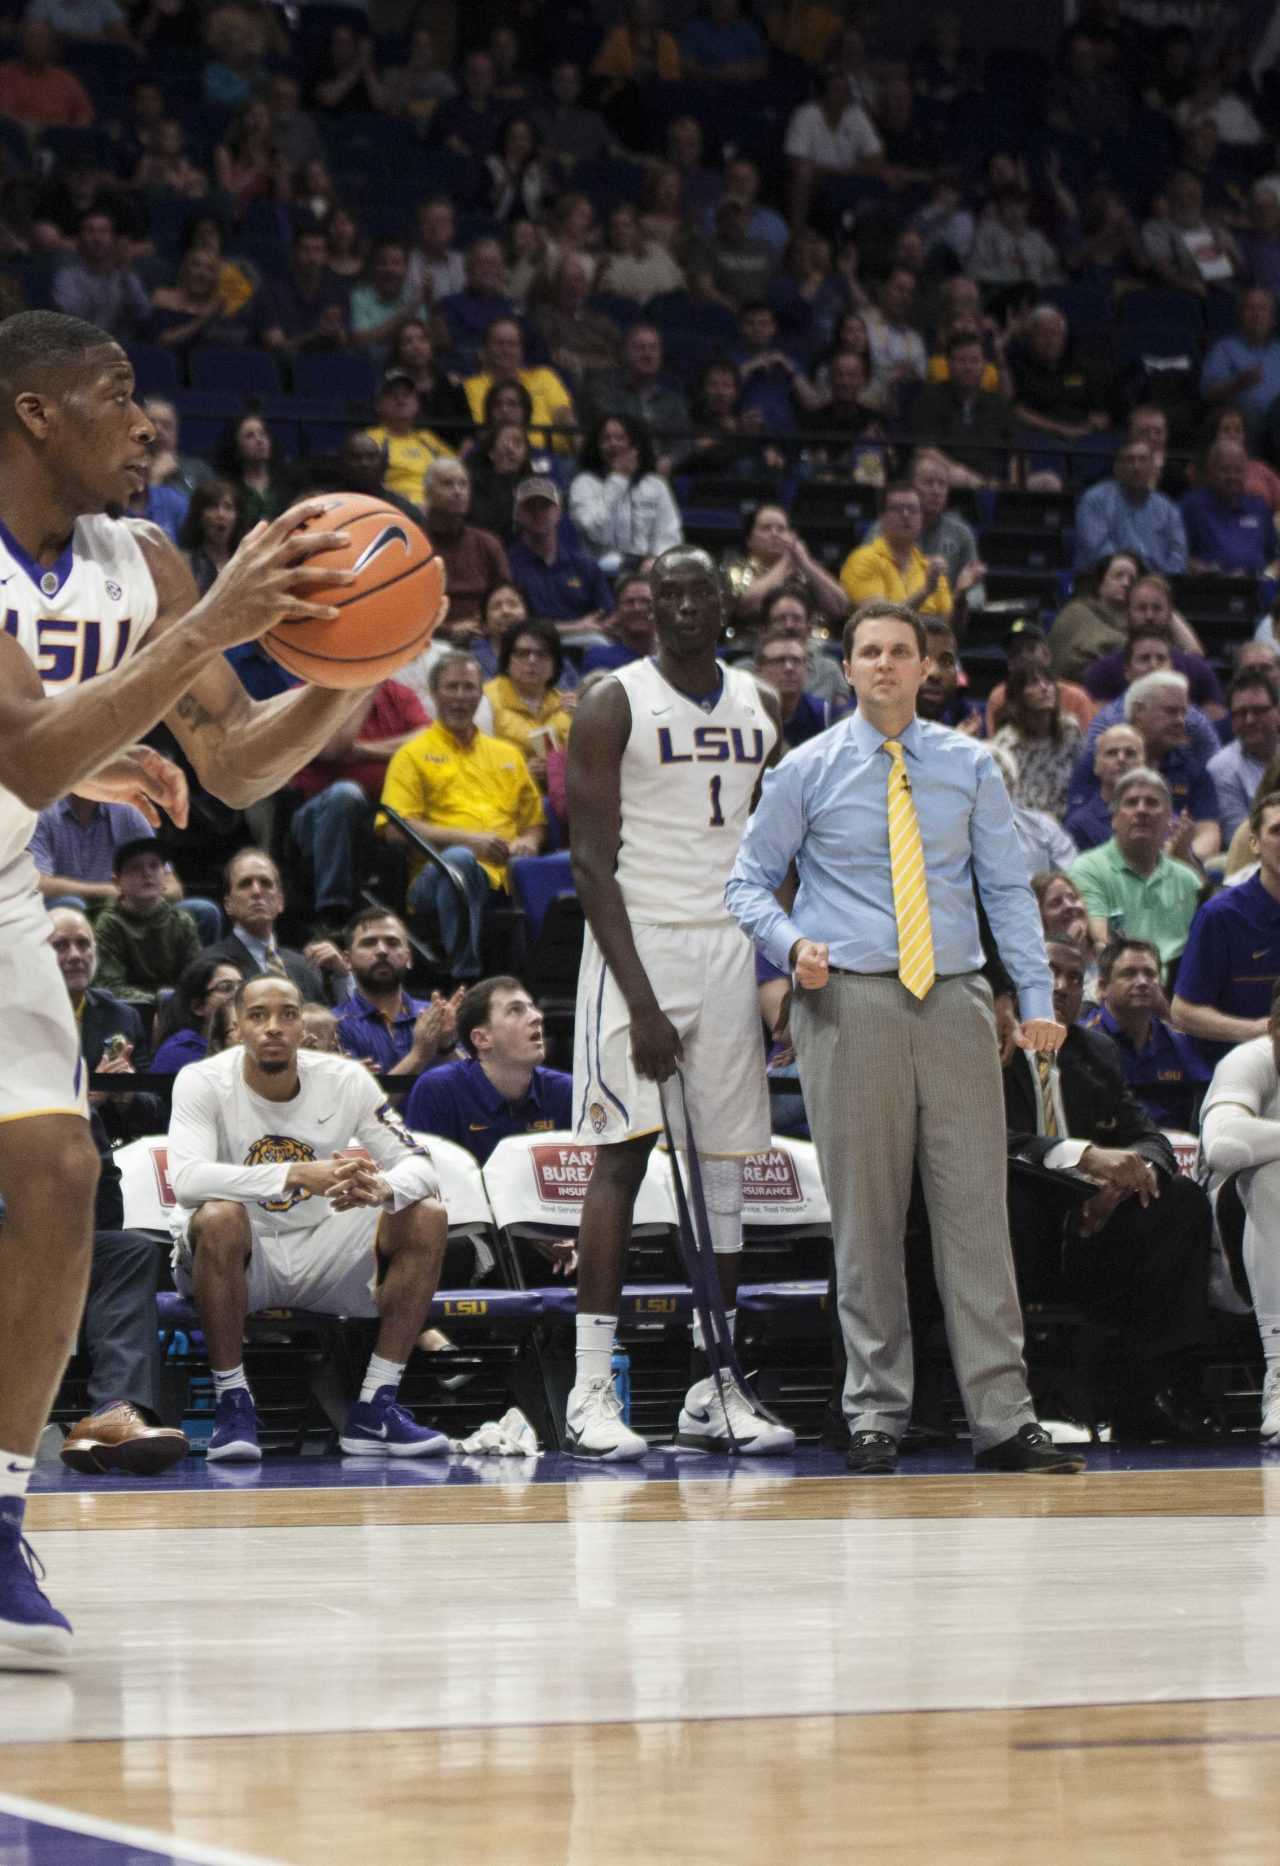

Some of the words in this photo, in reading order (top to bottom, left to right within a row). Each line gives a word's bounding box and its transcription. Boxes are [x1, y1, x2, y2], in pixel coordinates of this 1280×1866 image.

[656, 726, 765, 765] LSU
[708, 774, 725, 827] 1
[558, 1151, 597, 1166] FAR
[745, 1152, 786, 1166] ARM
[542, 1166, 594, 1182] BURE
[743, 1166, 789, 1181] REAU
[443, 1301, 488, 1316] LSU
[635, 1298, 677, 1313] LSU
